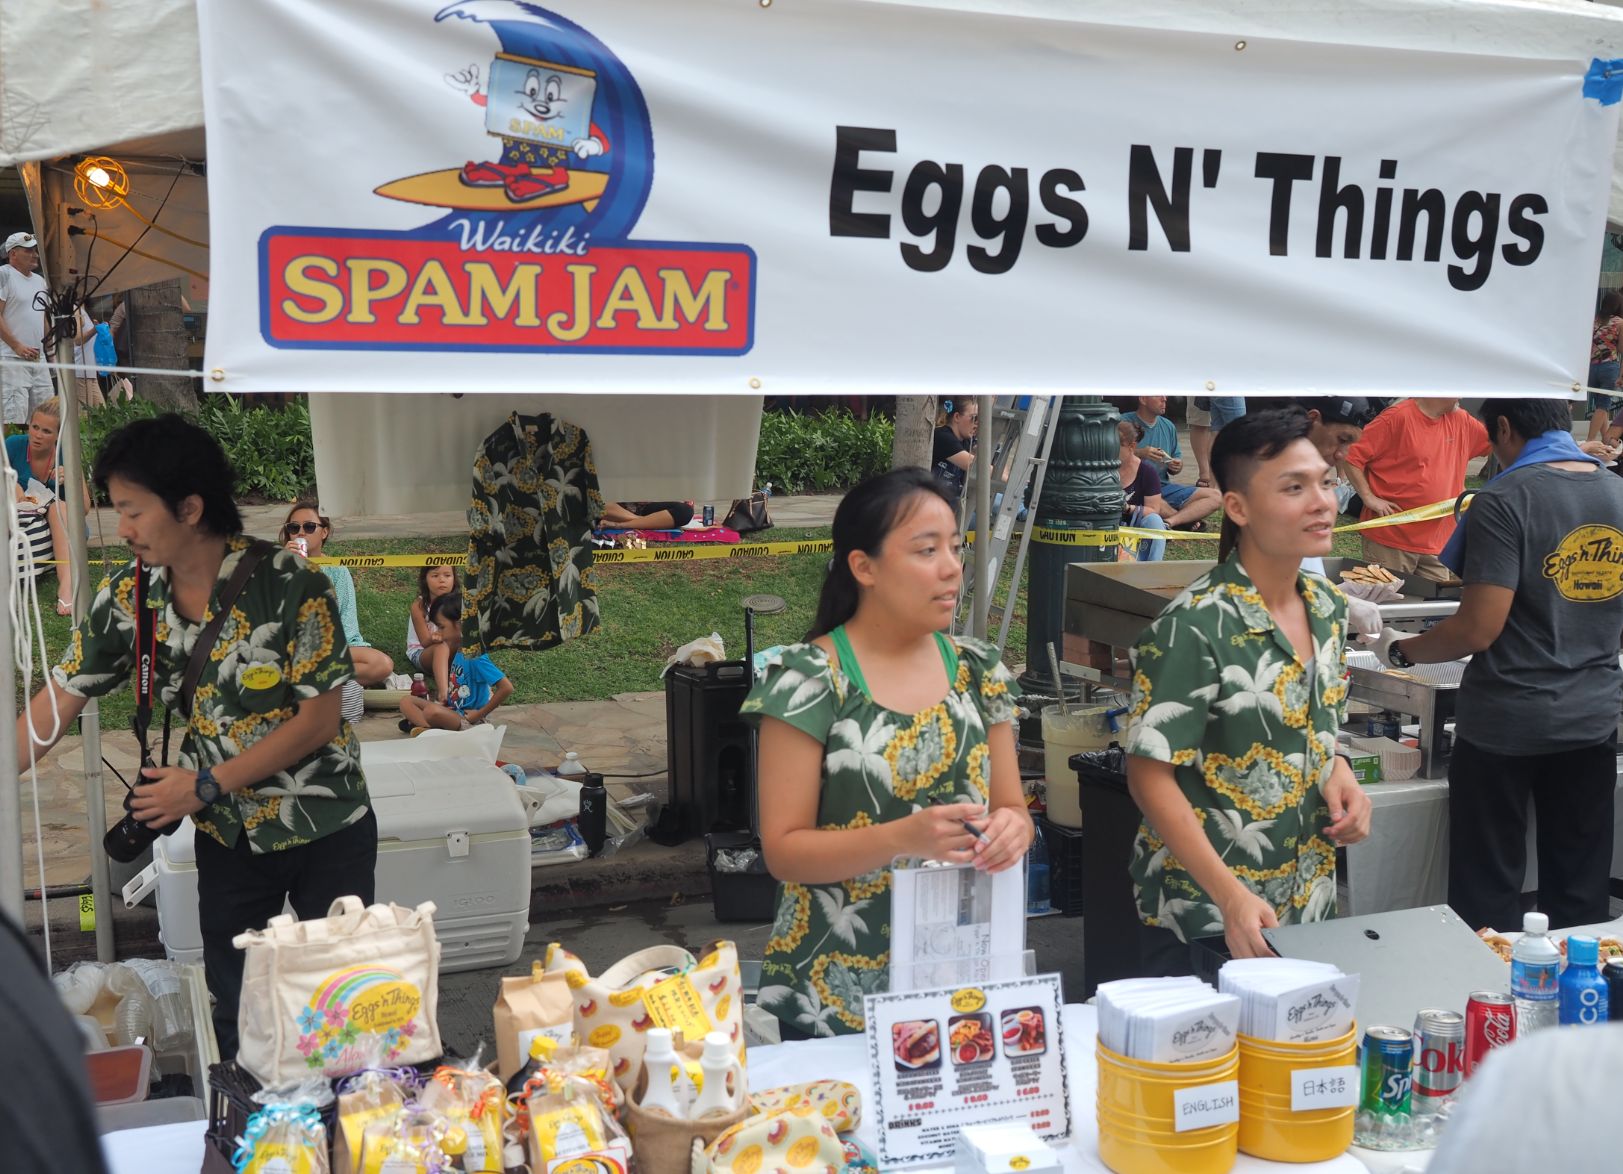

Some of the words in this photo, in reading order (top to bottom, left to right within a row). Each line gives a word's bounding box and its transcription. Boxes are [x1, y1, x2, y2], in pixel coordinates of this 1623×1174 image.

[508, 118, 566, 142] SPAM
[830, 126, 1089, 275] Eggs
[1128, 145, 1222, 253] N'
[1254, 152, 1549, 292] Things
[449, 218, 590, 255] Waikiki
[282, 255, 541, 327] SPAM
[546, 263, 731, 341] JAM
[1039, 530, 1076, 543] CAUTION
[653, 549, 694, 561] CAUTION
[729, 546, 769, 557] CUIDADO
[797, 543, 833, 554] AUTION
[339, 557, 385, 566] CAUTION
[1543, 552, 1578, 584] Eggs
[1573, 580, 1603, 591] Hawaii
[141, 653, 150, 695] Canon
[351, 1001, 380, 1025] Eggs
[385, 986, 420, 1016] Things
[1287, 1003, 1306, 1024] Eggs
[1311, 992, 1337, 1017] Things
[1303, 1076, 1347, 1097] 日本語
[1182, 1096, 1235, 1116] ENGLISH
